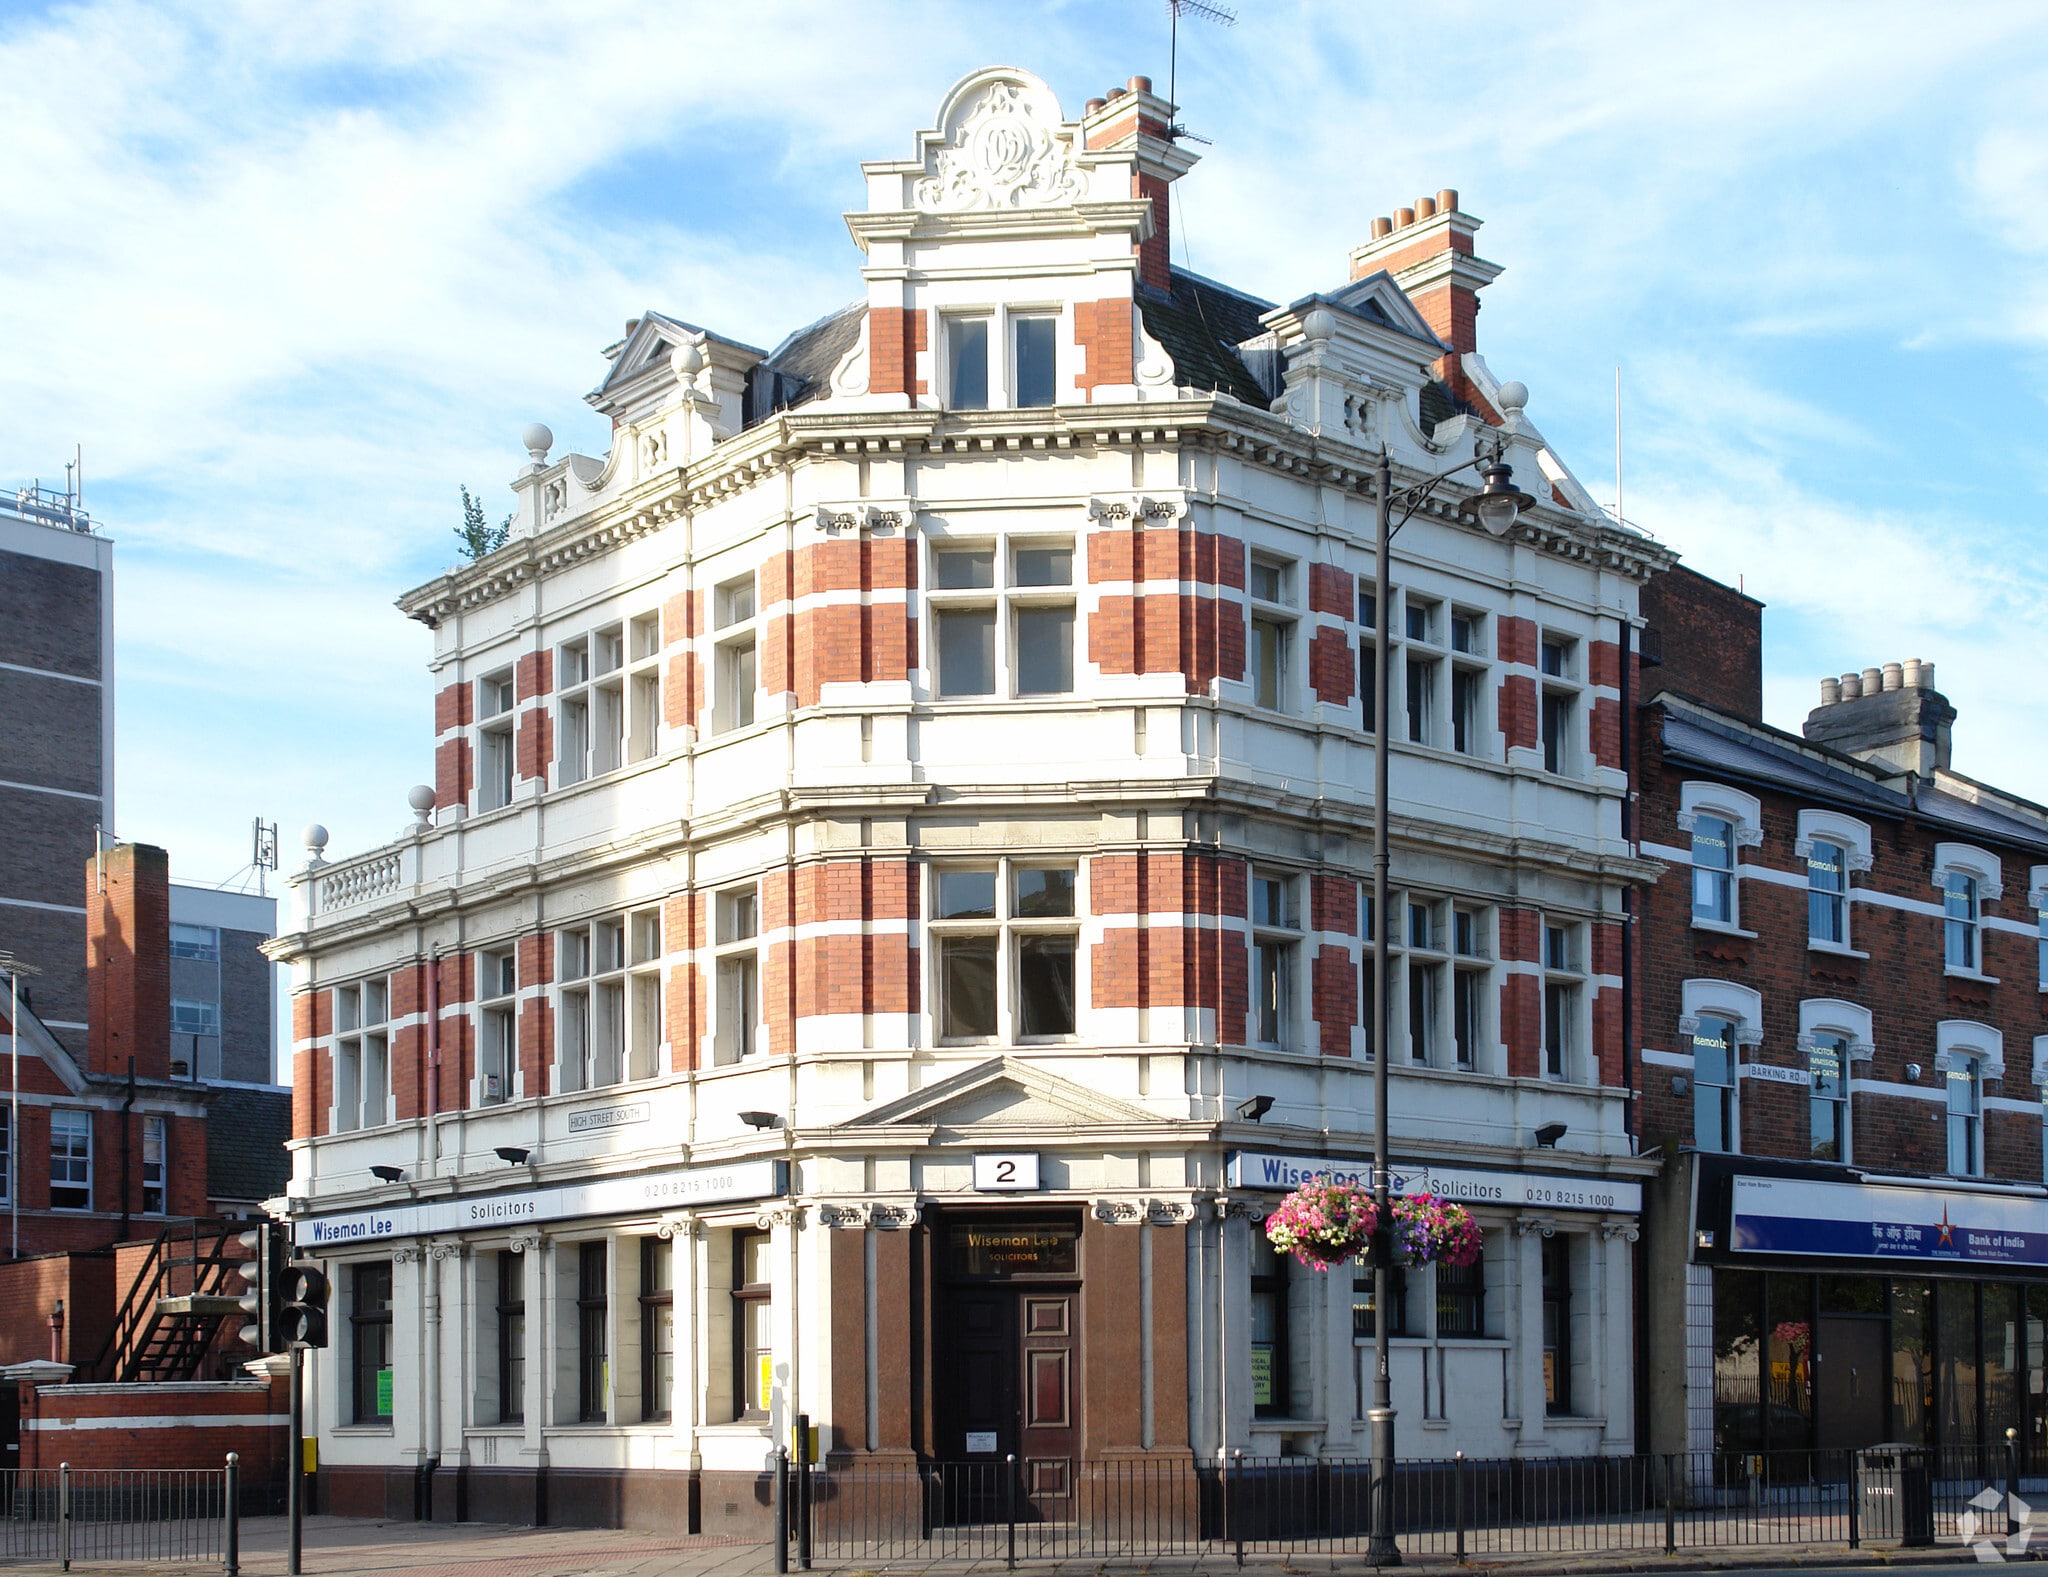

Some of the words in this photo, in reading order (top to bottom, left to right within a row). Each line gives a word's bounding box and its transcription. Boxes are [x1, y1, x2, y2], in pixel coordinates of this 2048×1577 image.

[1751, 1066, 1786, 1080] BARKING
[1789, 1071, 1800, 1081] RD
[571, 1115, 587, 1128] HIGH
[589, 1112, 614, 1126] STREET
[616, 1108, 640, 1121] SOUTH
[997, 1161, 1016, 1182] 2
[1369, 1165, 1405, 1192] Le
[707, 1176, 733, 1189] 1000
[1431, 1180, 1502, 1198] Solicitors
[1527, 1189, 1551, 1201] 020
[1557, 1192, 1584, 1204] 8215
[1589, 1194, 1614, 1207] 1000
[471, 1201, 535, 1219] Solicitors
[313, 1220, 366, 1241] Wiseman
[370, 1215, 393, 1235] Lee
[968, 1233, 1029, 1247] Wiseman
[1033, 1233, 1059, 1247] Lee
[1968, 1233, 1991, 1246] Bank
[1993, 1236, 2002, 1247] of
[2004, 1236, 2025, 1248] India
[989, 1253, 1039, 1261] SOLICITORS
